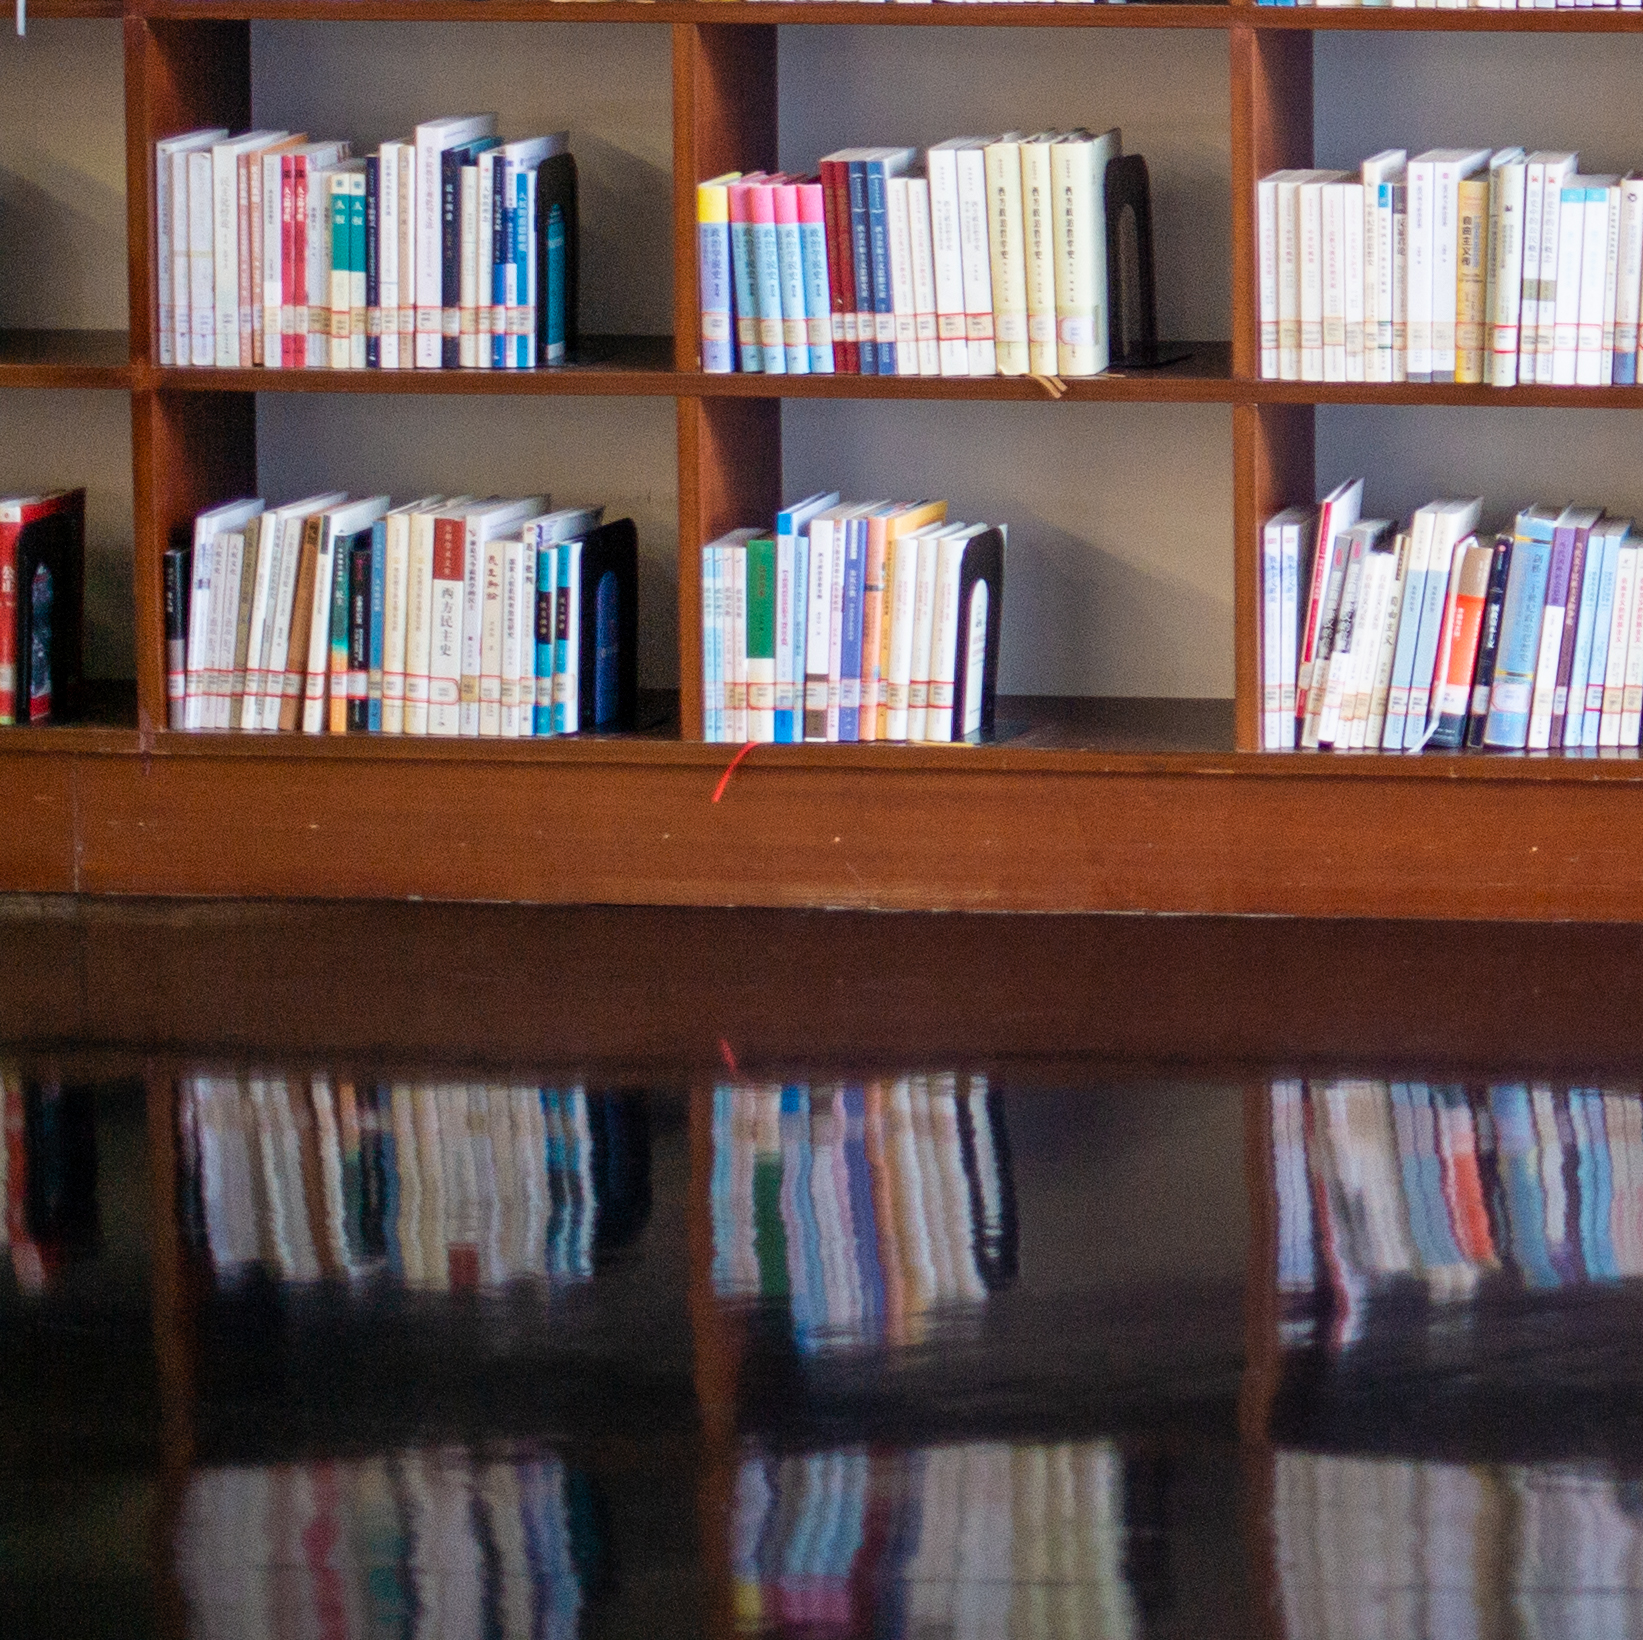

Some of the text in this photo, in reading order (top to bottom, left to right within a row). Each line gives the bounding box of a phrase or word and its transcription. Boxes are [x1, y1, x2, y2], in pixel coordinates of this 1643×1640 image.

[440, 587, 455, 657] 西方民主史
